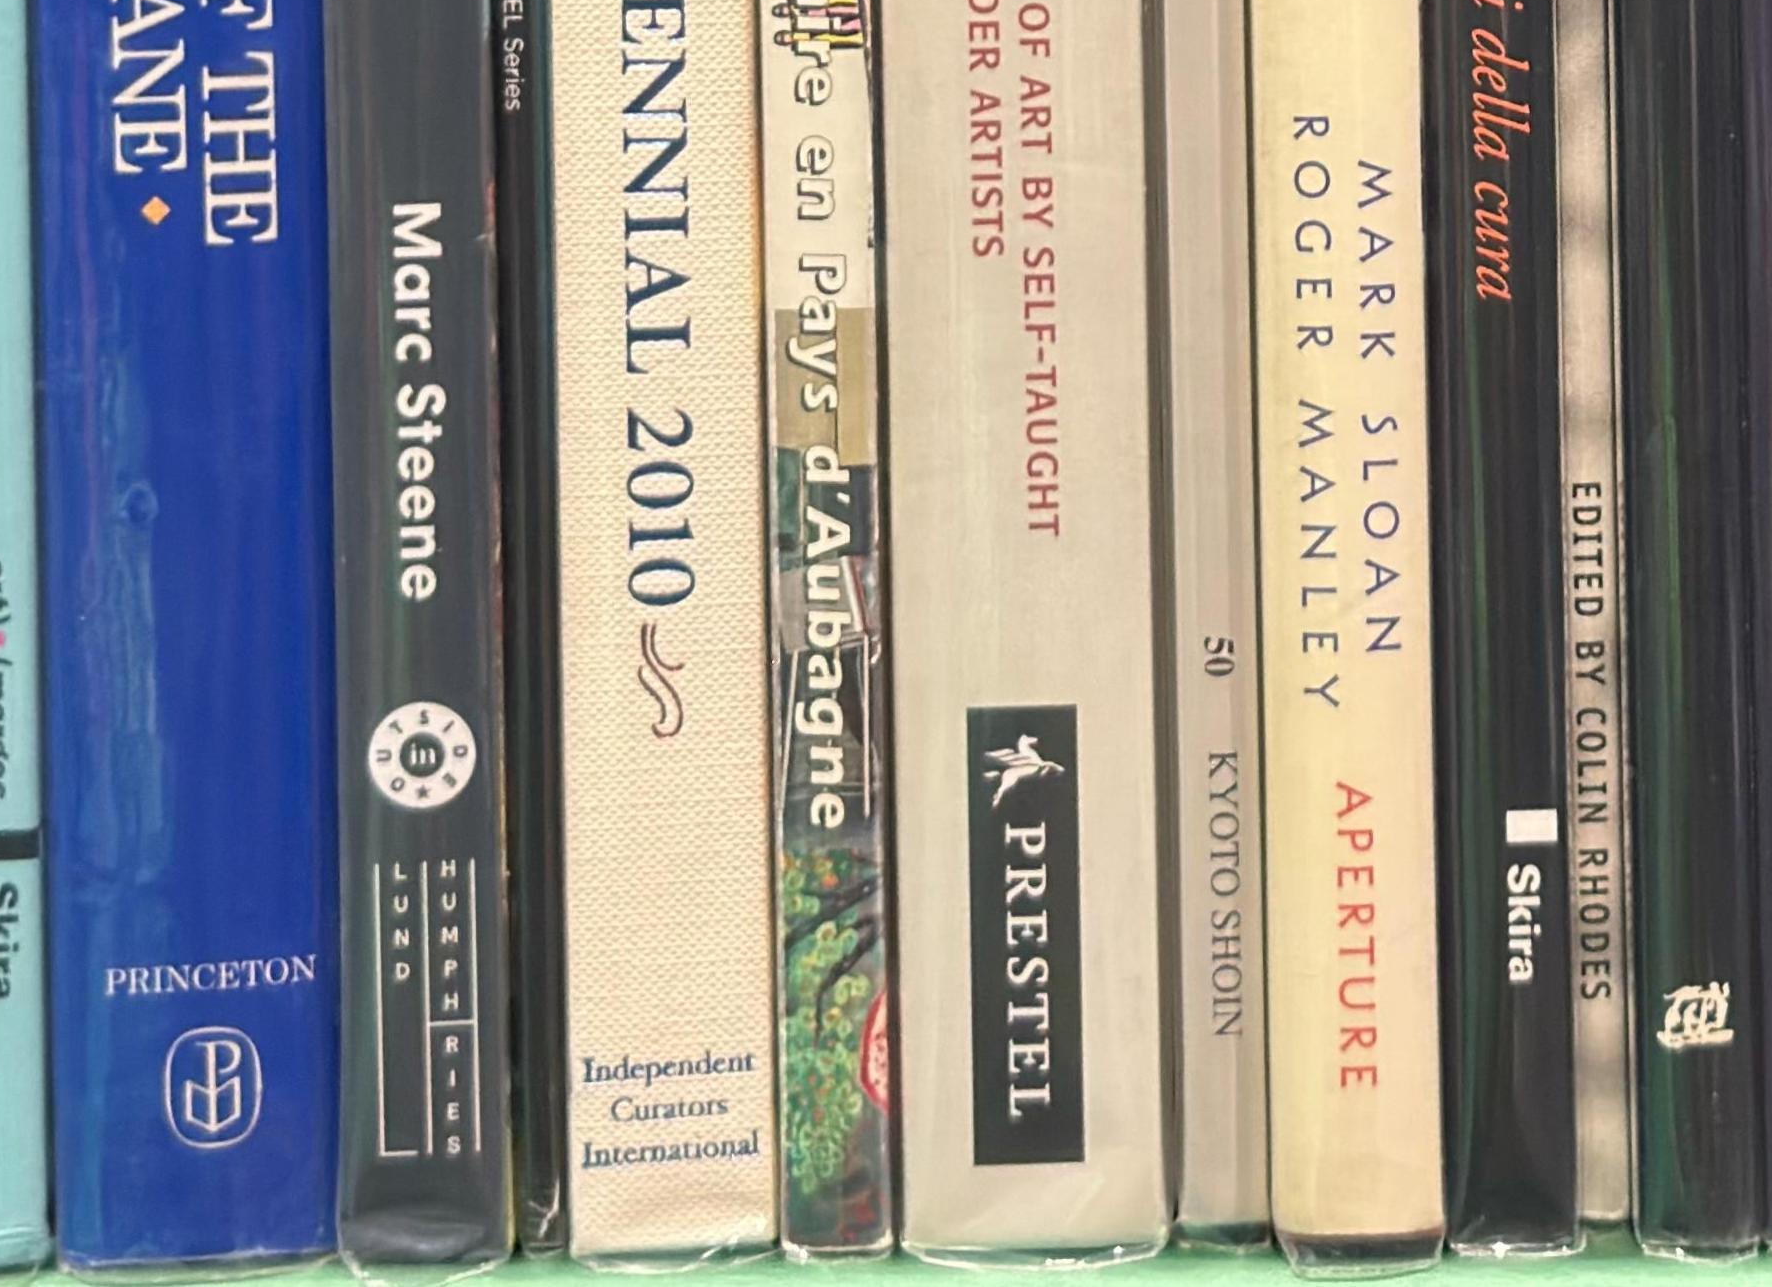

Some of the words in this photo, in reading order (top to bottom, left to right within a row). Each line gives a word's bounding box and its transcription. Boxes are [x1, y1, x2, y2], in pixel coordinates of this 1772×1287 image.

[503, 37, 527, 110] Series
[1470, 30, 1530, 160] della
[201, 51, 278, 247] THE
[797, 133, 842, 221] en
[1472, 181, 1518, 299] cura
[786, 252, 848, 411] Pays
[627, 406, 695, 606] 2010
[795, 445, 852, 829] d'Aubagne
[1203, 636, 1235, 677] 50
[1207, 751, 1241, 897] KYOTO
[105, 954, 316, 997] PRINCETON
[1002, 822, 1050, 1119] PRESTEL
[1211, 910, 1244, 1036] SHOIN
[1334, 781, 1379, 1089] APERTURE
[582, 1049, 755, 1083] Independent
[611, 1096, 728, 1121] Curators
[582, 1130, 759, 1167] International
